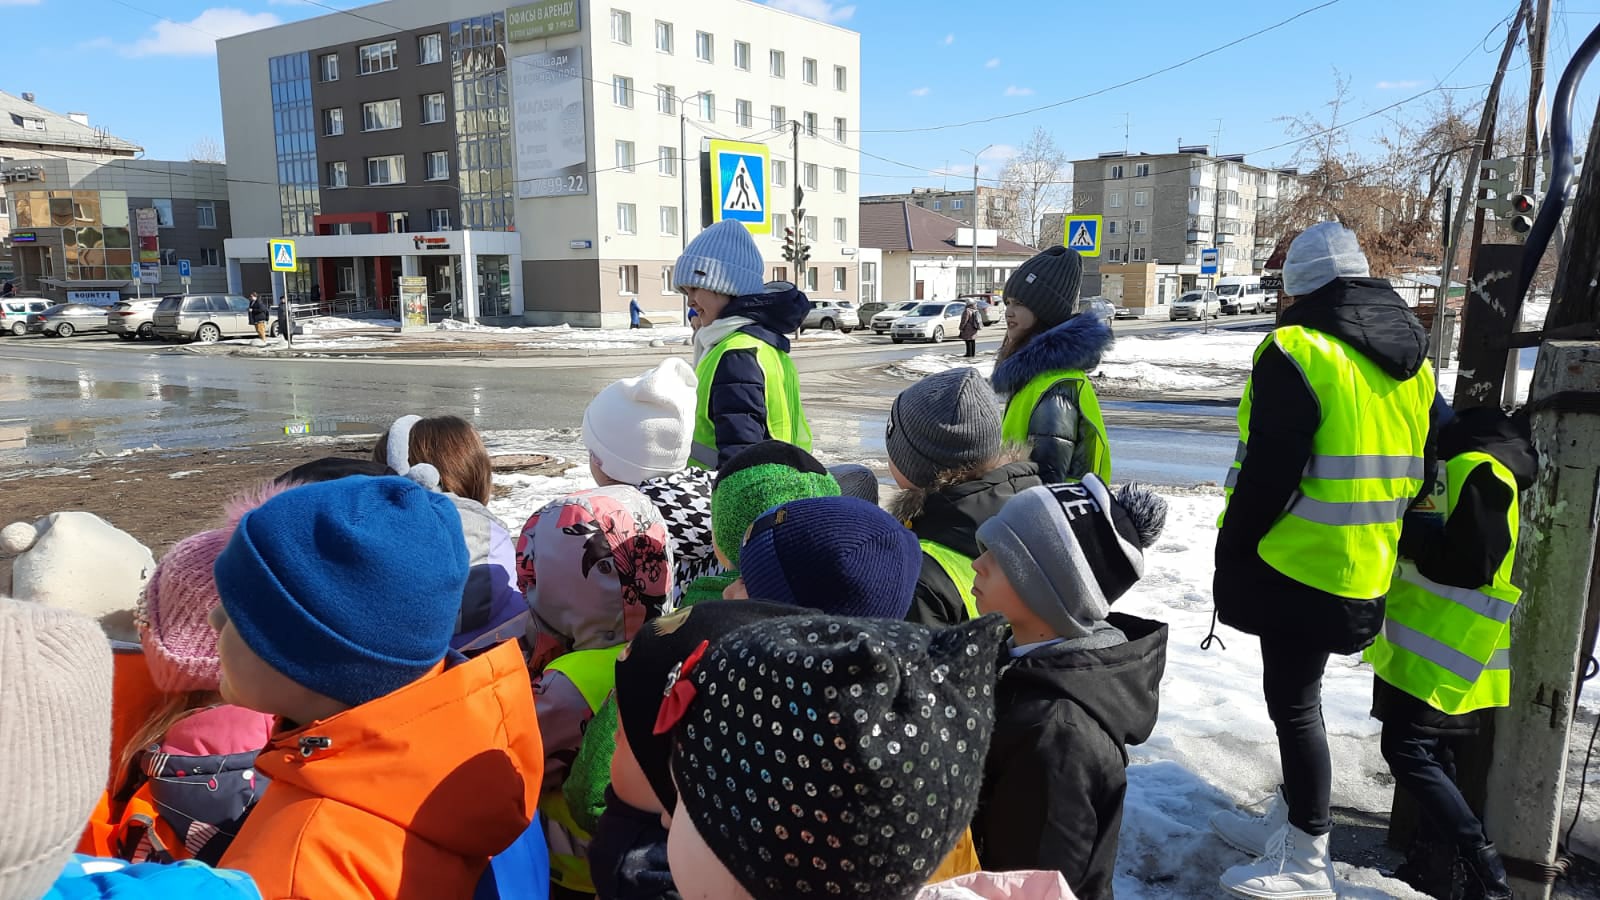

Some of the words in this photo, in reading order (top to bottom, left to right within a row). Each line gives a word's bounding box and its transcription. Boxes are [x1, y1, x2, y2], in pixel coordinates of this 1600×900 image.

[509, 10, 536, 25] ОФИСЫ
[537, 7, 542, 20] В
[543, 1, 574, 19] АРЕНДУ
